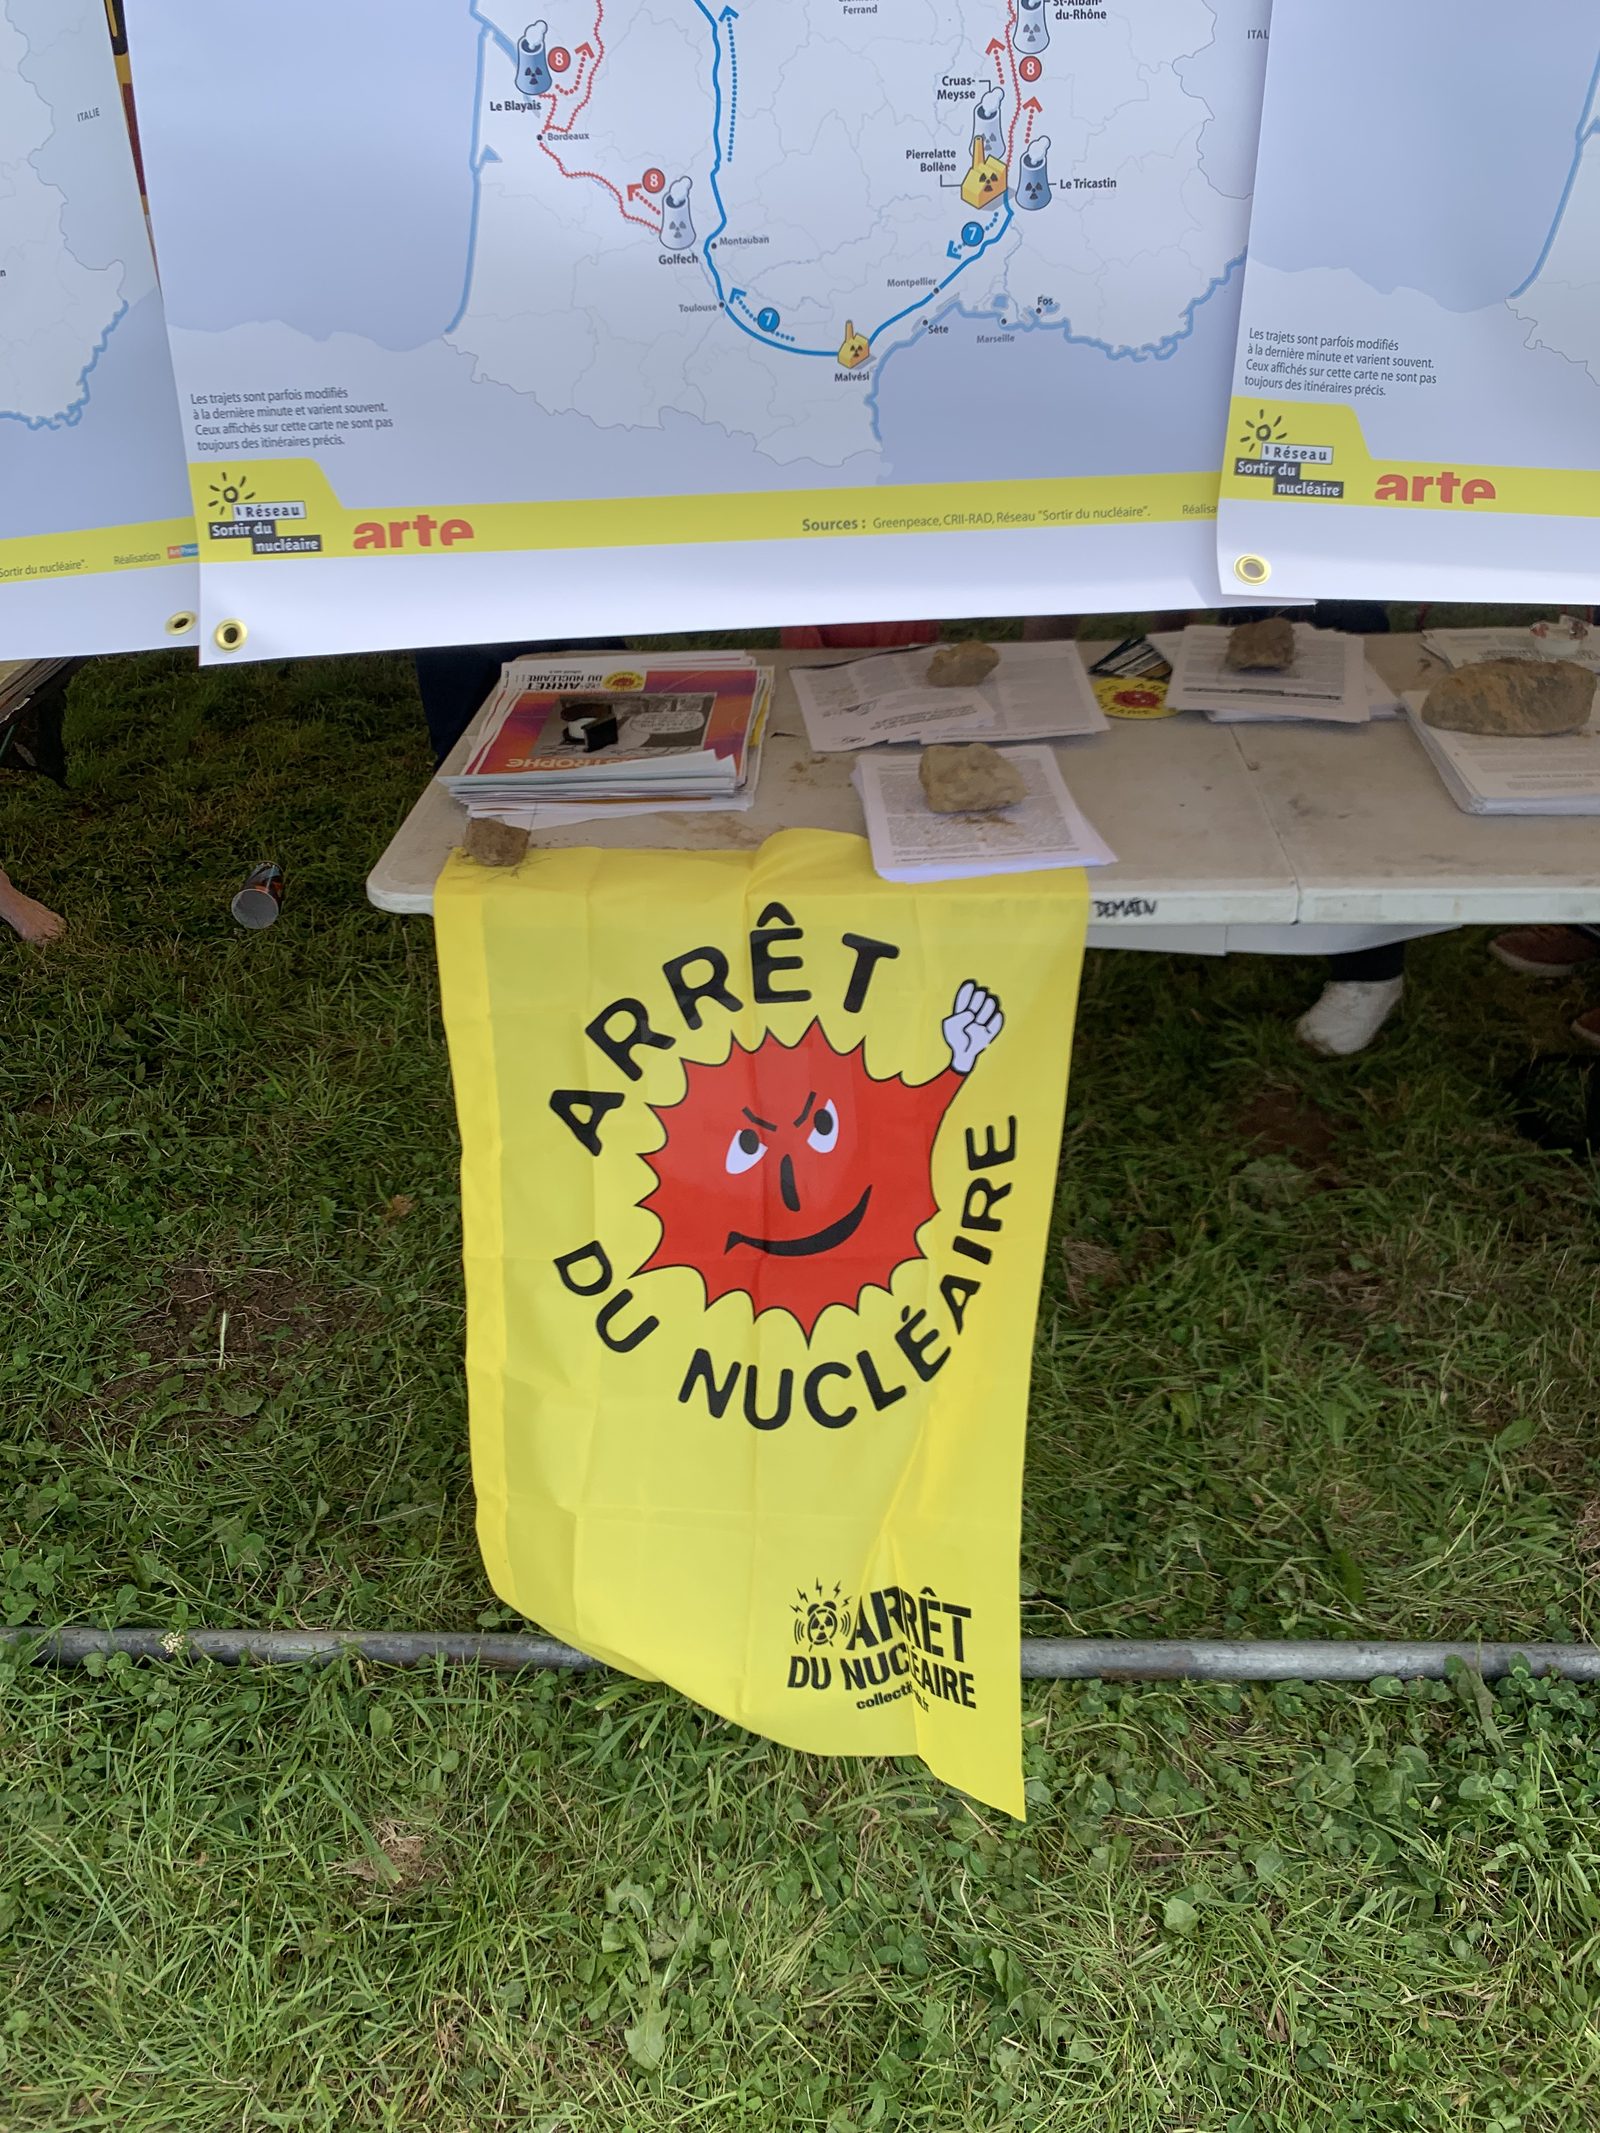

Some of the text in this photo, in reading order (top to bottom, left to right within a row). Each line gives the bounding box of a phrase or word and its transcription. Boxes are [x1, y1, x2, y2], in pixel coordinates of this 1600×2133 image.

[842, 4, 878, 15] Ferrand
[1055, 8, 1107, 20] du-Rhône
[1247, 29, 1269, 40] ITAL
[941, 75, 976, 87] Cruas-
[936, 89, 976, 102] Meysse
[489, 99, 542, 114] Le Blayais
[77, 107, 101, 122] ITALIE
[547, 131, 590, 142] Bordeaux
[905, 149, 957, 160] Pierrelatte
[920, 161, 957, 173] Bollène
[1060, 177, 1117, 189] Le Tricastin
[719, 235, 770, 246] Montauban
[658, 252, 699, 266] Golfech
[886, 275, 938, 289] Montpellier
[678, 302, 718, 314] Toulouse
[1037, 296, 1054, 306] Fos
[928, 324, 949, 335] Sète
[976, 333, 1016, 344] Marseille
[1249, 327, 1399, 351] Les trajets sont parfois modifiés
[1247, 342, 1434, 369] à la dernière minute et varient souvent.
[834, 371, 870, 382] Malvési
[1246, 358, 1437, 386] Ceux affichés sur cette carte ne sont pas
[1244, 375, 1386, 397] toujours des itinéraires précis.
[190, 386, 349, 406] Les trajets sont parfois modifiés
[193, 402, 388, 420] à la dernière minute et varient souvent.
[195, 418, 394, 436] Ceux affichés sur cette carte ne sont pas
[197, 433, 345, 453] toujours des itinéraires précis.
[1273, 445, 1328, 461] Réseau
[1237, 460, 1296, 477] Sortir du
[1277, 481, 1340, 497] nucléaire
[1374, 471, 1497, 504] arte
[245, 504, 301, 518] Réseau
[801, 517, 858, 532] Sources
[873, 515, 942, 530] Greenpeace,
[943, 511, 995, 526] CRII-RAD,
[996, 511, 1035, 523] Réseau
[1075, 507, 1090, 519] du
[211, 521, 273, 537] Sortir du
[353, 514, 475, 550] arte
[254, 537, 320, 553] nucléaire
[113, 551, 161, 566] Réalisation
[25, 564, 38, 575] du
[549, 901, 900, 1157] ARRÊT
[553, 1114, 1018, 1431] DU NUCLÉAIRE
[845, 1585, 972, 1663] ARRÊT
[787, 1655, 832, 1691] DU
[840, 1641, 977, 1710] NUCÉAIRE
